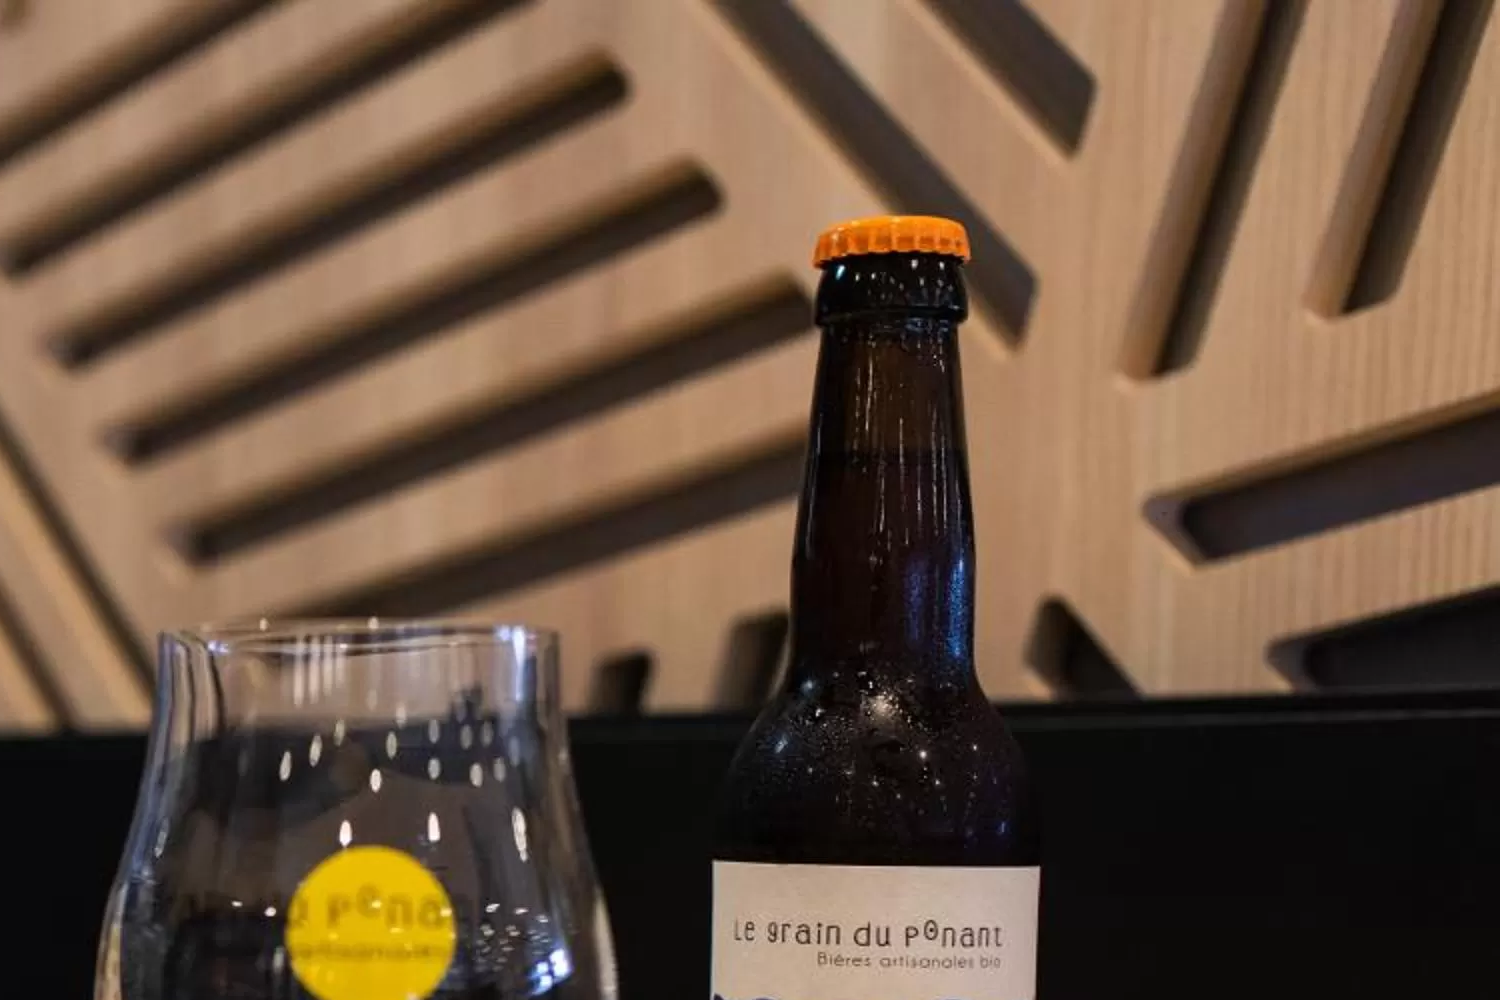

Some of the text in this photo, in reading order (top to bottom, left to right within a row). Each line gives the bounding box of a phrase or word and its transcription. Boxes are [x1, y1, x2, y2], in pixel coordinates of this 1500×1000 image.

[734, 917, 1003, 948] Le grain du Ponant
[817, 951, 1001, 969] Bières artisanales bio
